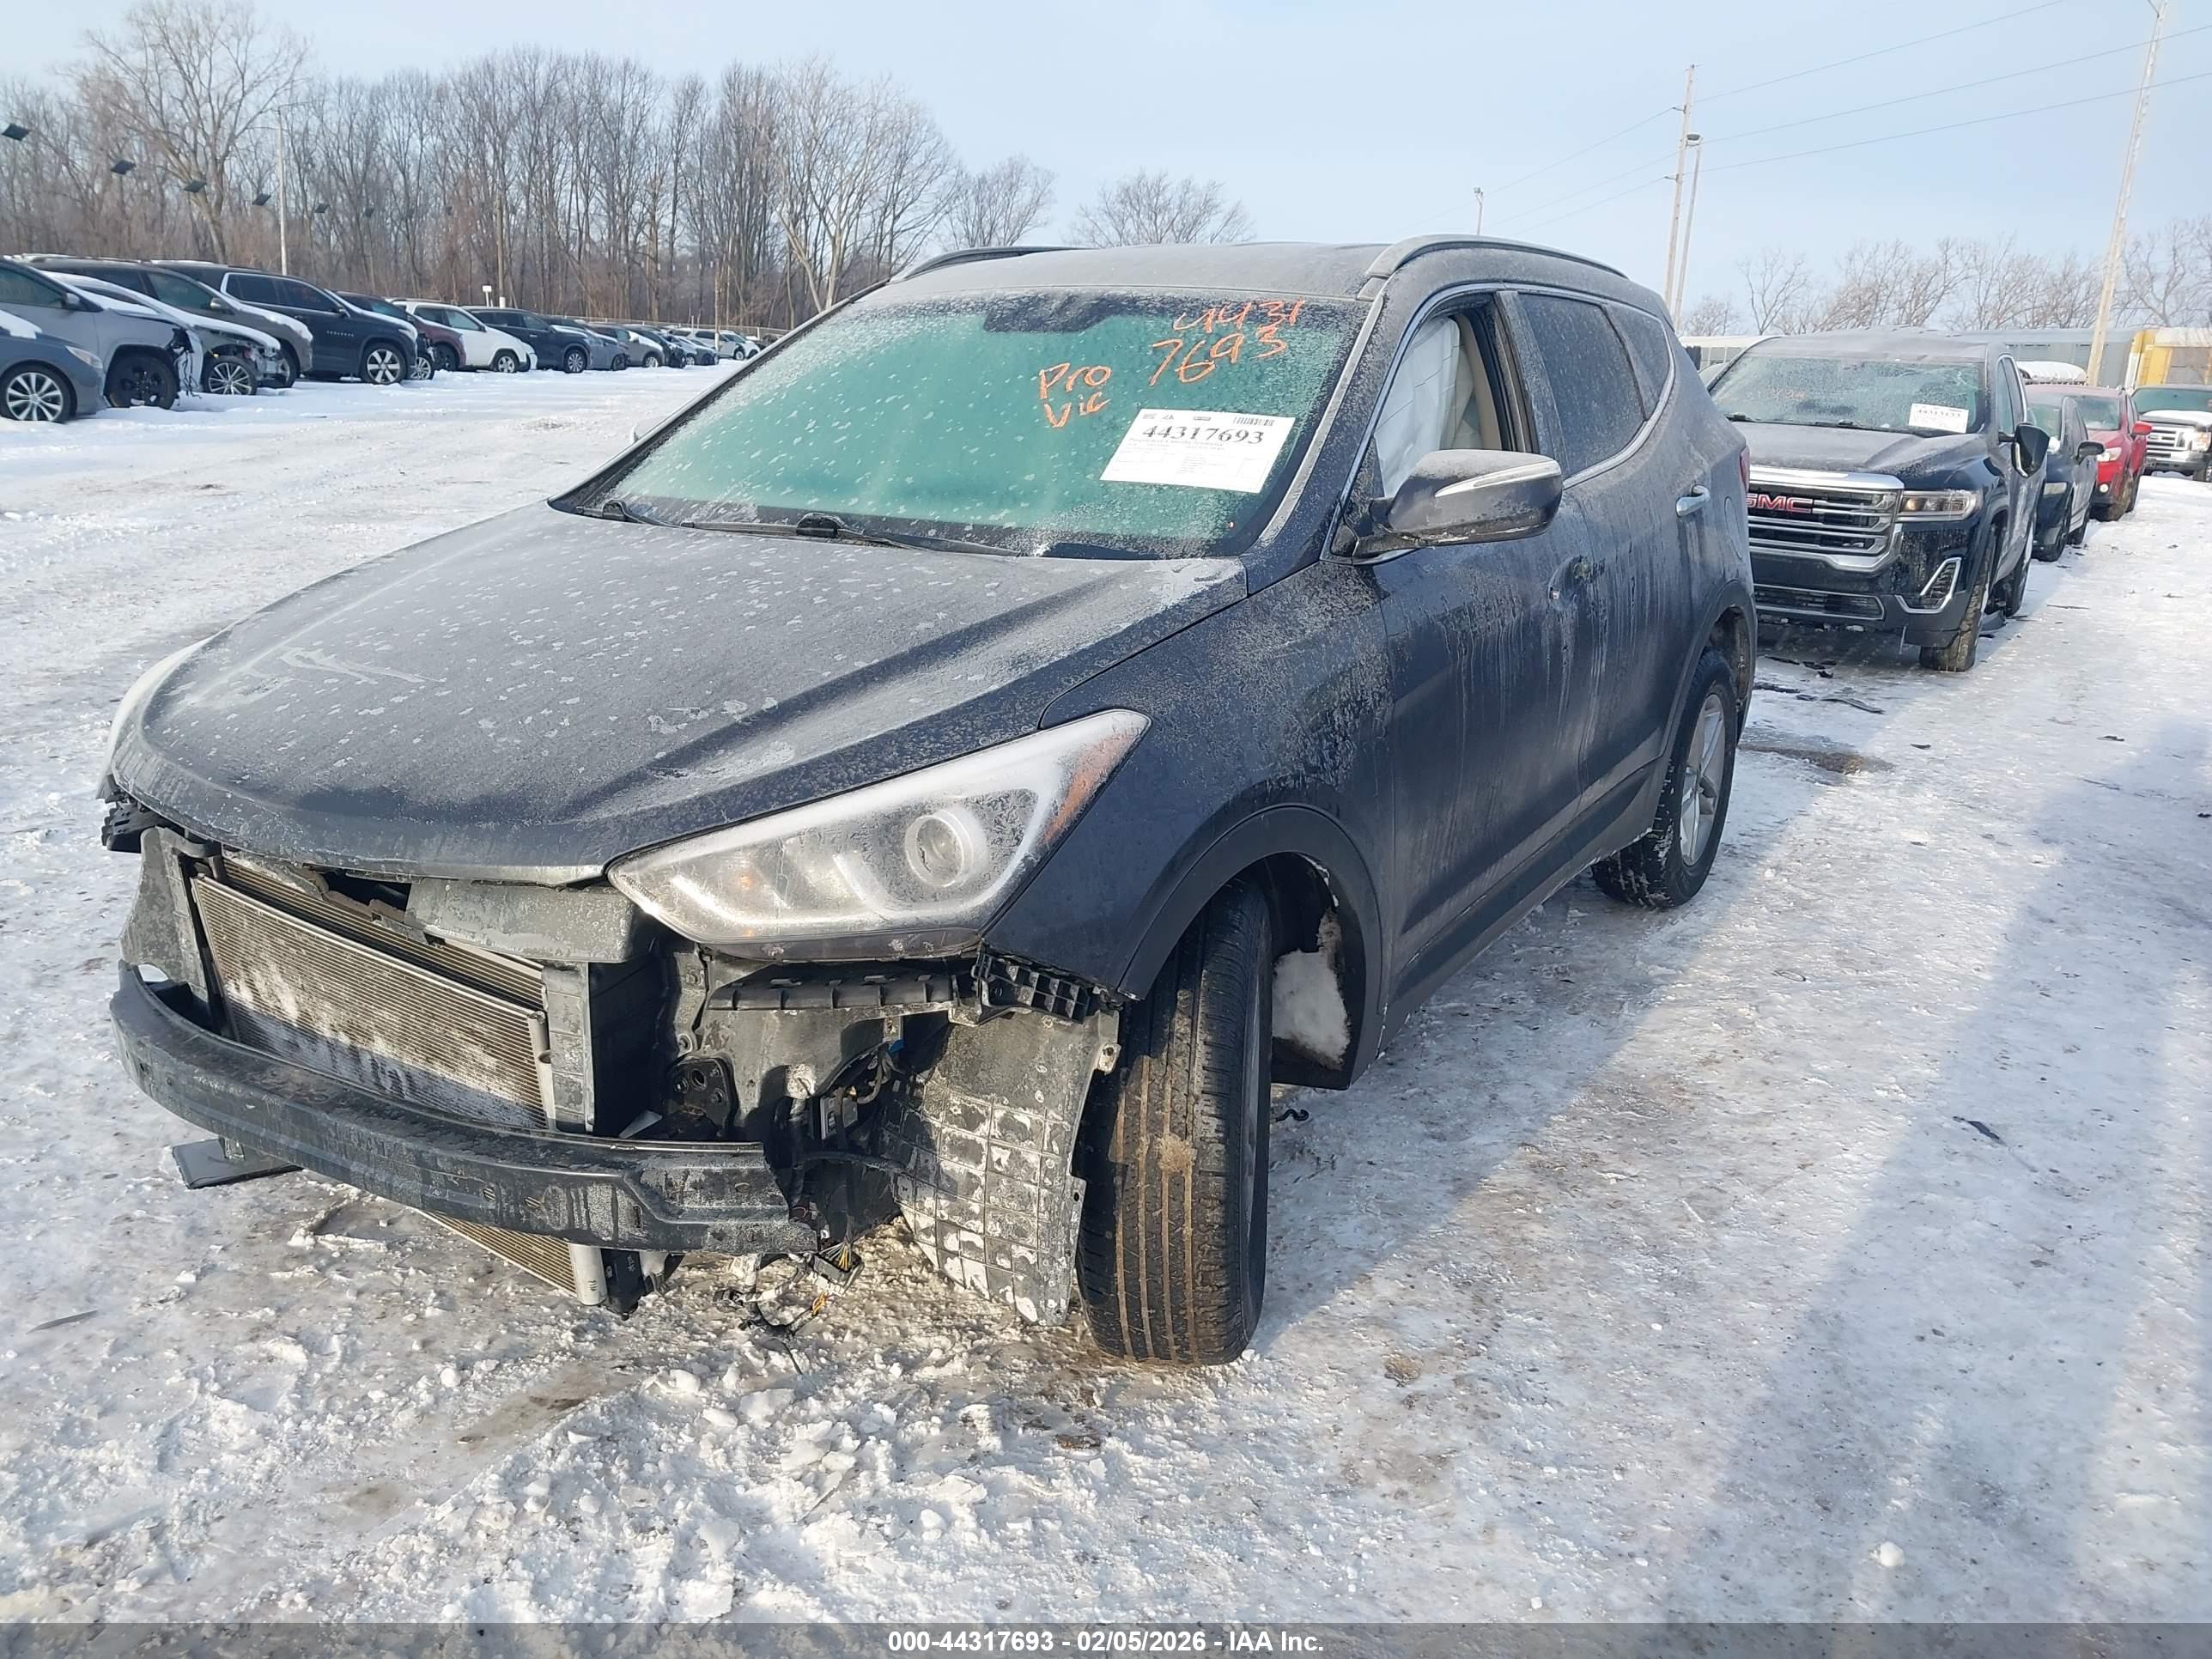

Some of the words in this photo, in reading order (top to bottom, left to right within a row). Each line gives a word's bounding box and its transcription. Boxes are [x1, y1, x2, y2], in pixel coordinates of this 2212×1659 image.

[1149, 326, 1288, 386] 7693
[1038, 362, 1112, 400] Pro
[1141, 424, 1265, 445] 44317693
